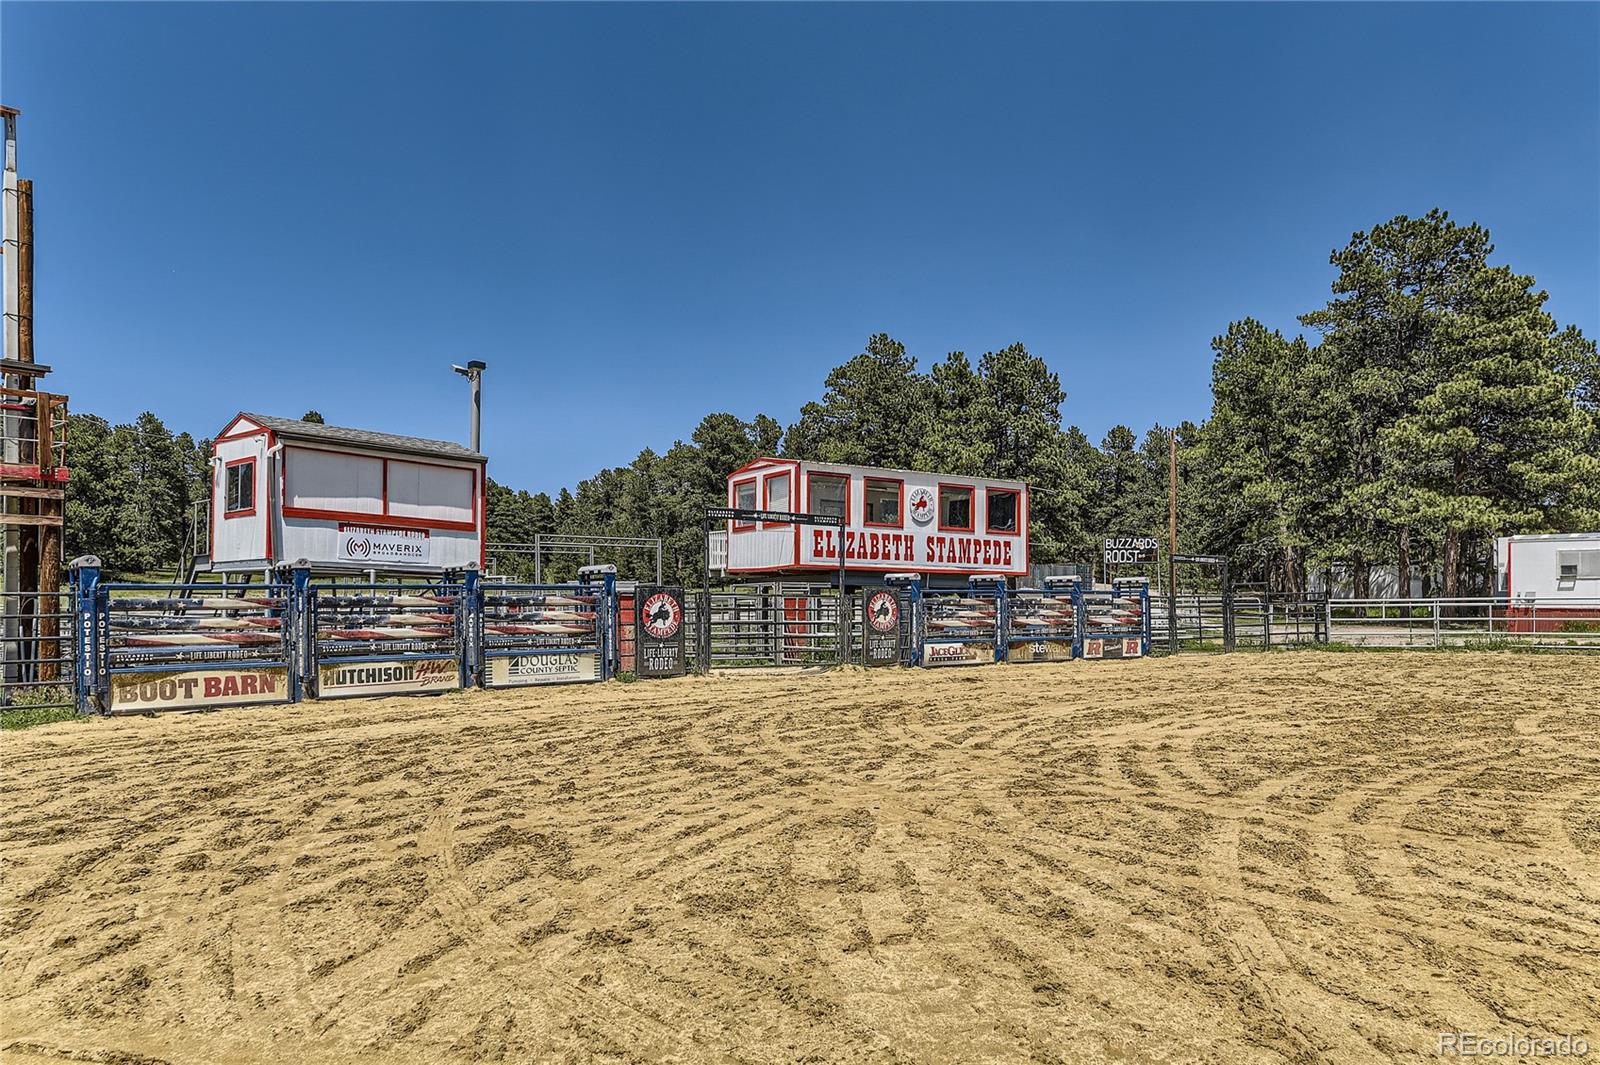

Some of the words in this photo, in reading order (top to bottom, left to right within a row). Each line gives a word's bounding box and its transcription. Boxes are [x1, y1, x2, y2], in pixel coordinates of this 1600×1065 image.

[373, 542, 422, 553] MAVERIX
[813, 529, 914, 562] ELIZABETH
[926, 535, 1012, 566] STAMPEDE
[1105, 538, 1158, 550] BUZZARDS
[1105, 550, 1140, 563] ROOST
[83, 612, 92, 676] POTESTIO
[190, 651, 202, 660] LIFE
[204, 650, 226, 660] LIBERTY
[228, 650, 248, 659] RODEO
[520, 655, 578, 667] DOUGLAS
[649, 658, 673, 670] RODEO
[323, 666, 414, 686] HUTCHISON
[420, 675, 456, 687] BRAND
[118, 678, 198, 704] BOOT
[203, 674, 276, 698] BARN
